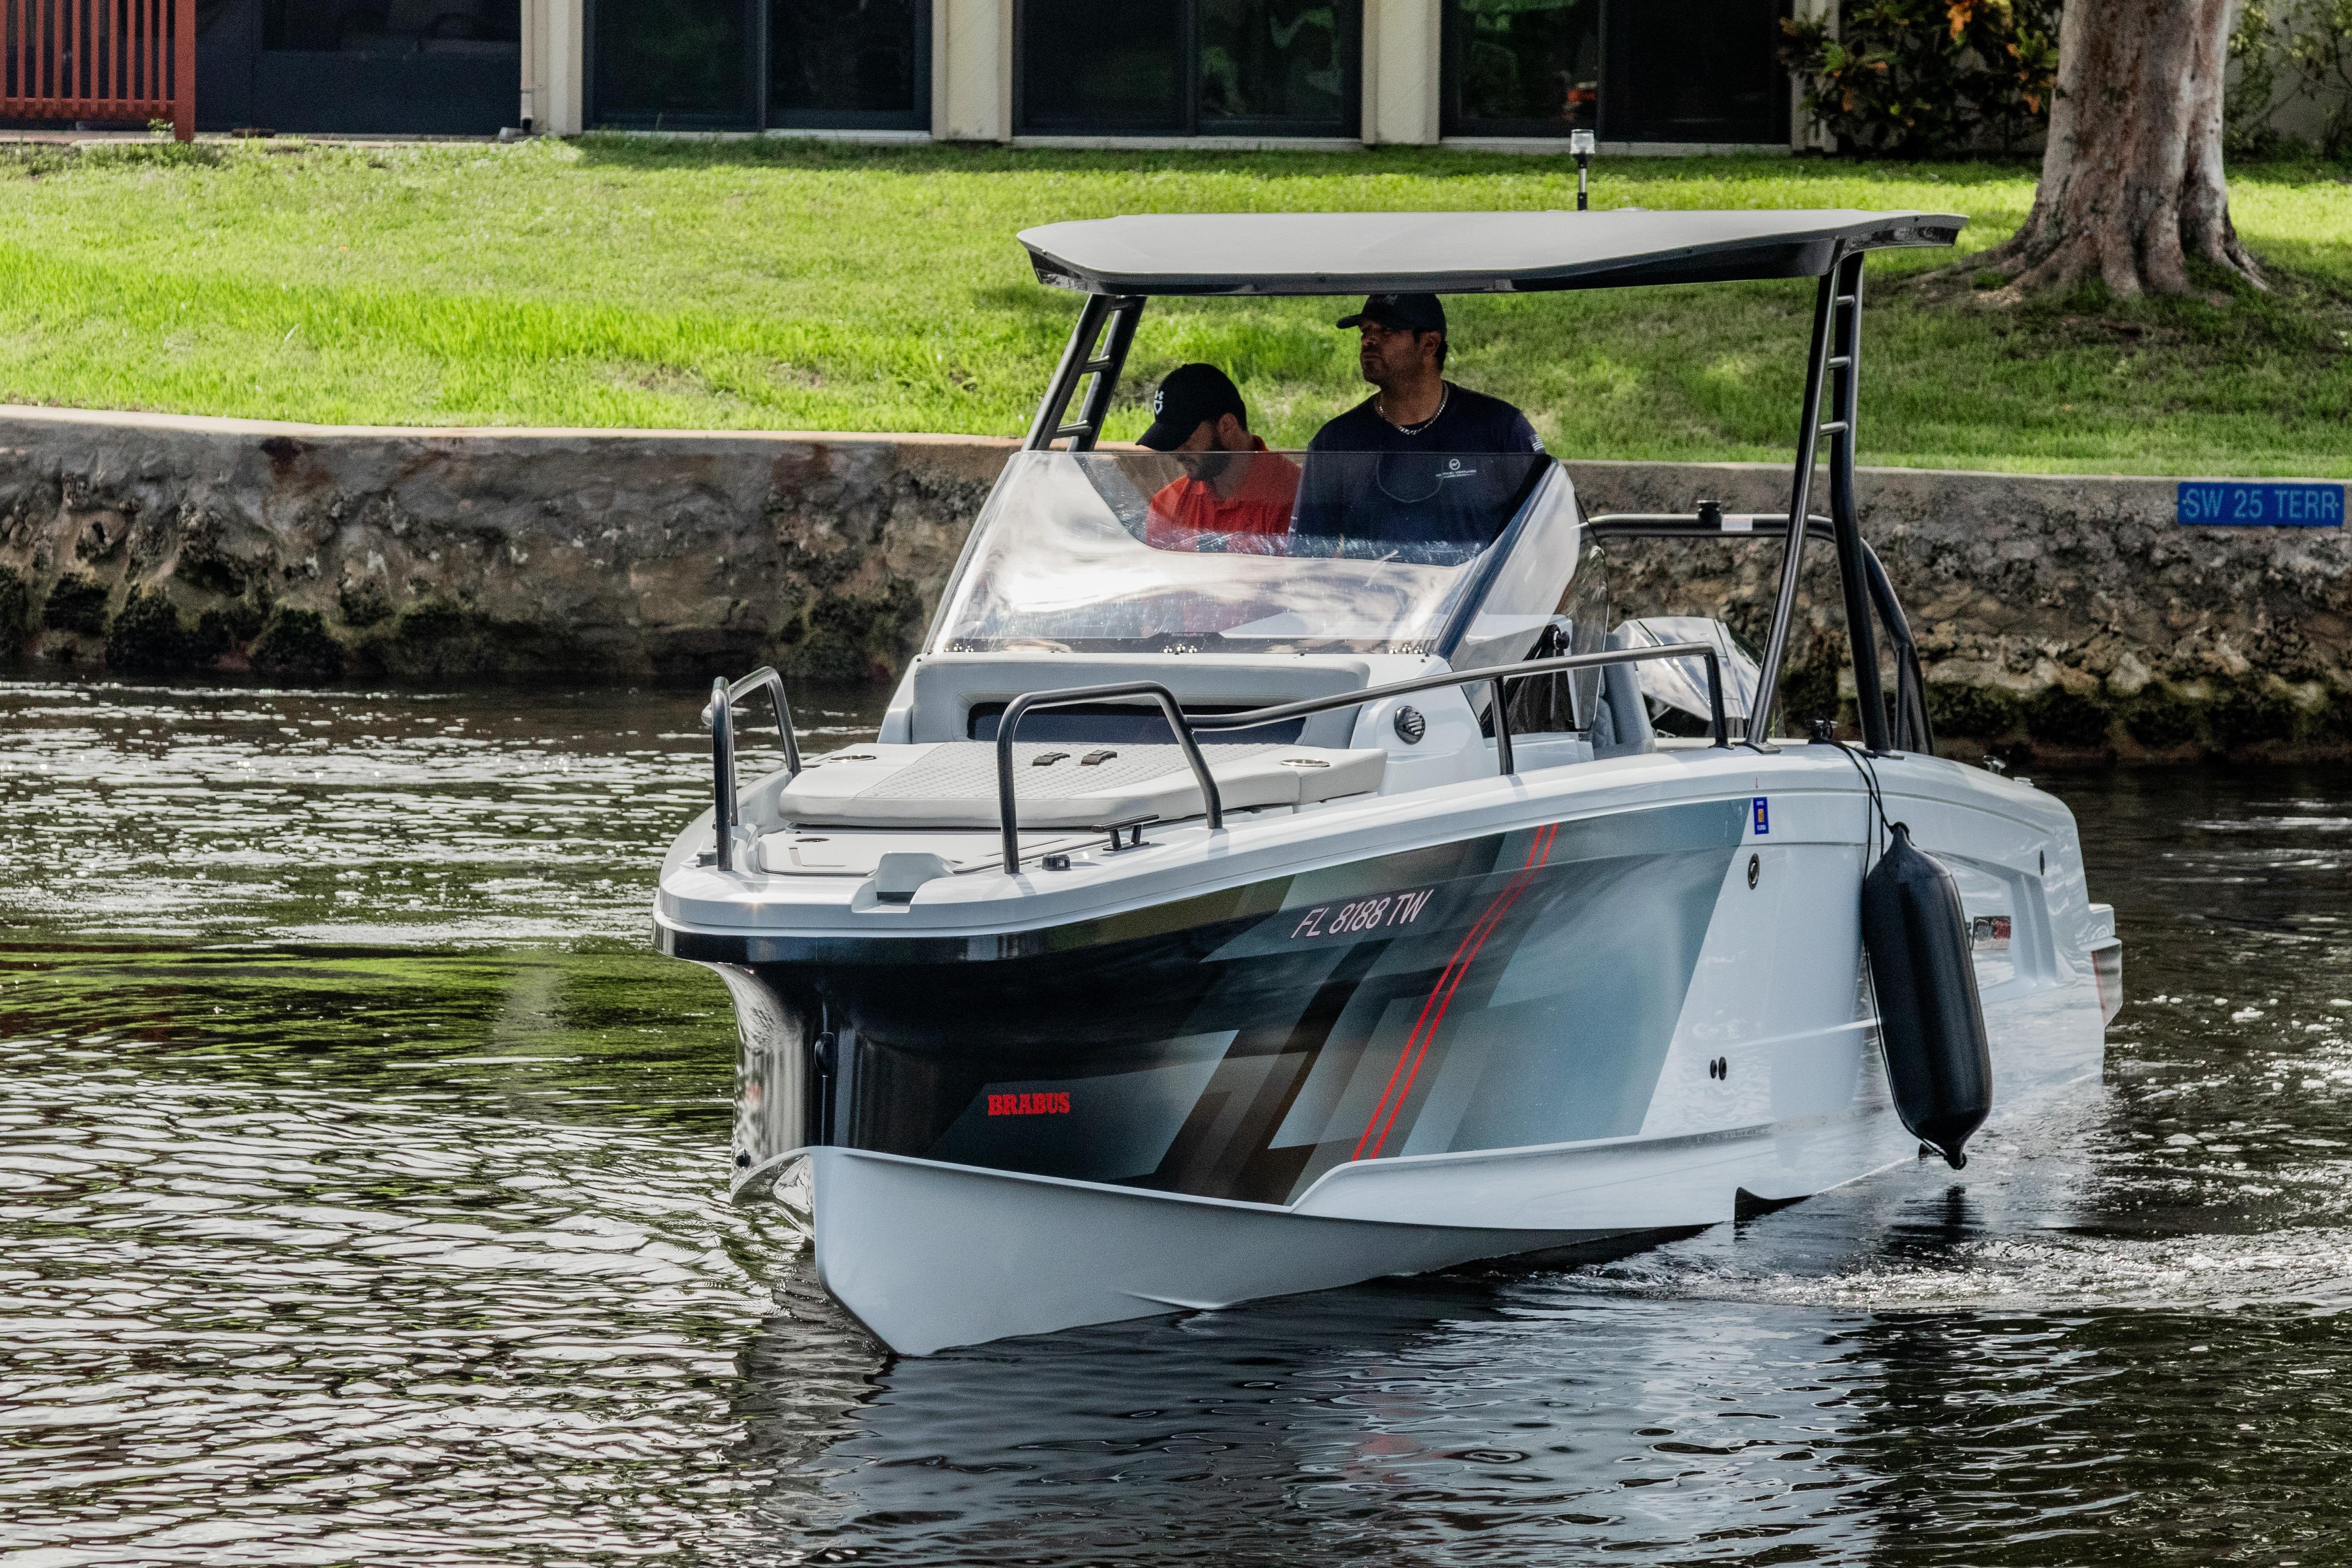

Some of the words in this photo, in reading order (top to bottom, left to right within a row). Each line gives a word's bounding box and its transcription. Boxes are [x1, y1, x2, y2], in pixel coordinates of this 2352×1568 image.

[2185, 488, 2224, 519] SW
[2234, 489, 2263, 519] 25
[2275, 490, 2337, 519] TERR
[1290, 907, 1330, 938] FL
[1328, 897, 1391, 934] 8188
[1386, 888, 1435, 926] TW
[988, 1093, 1070, 1115] BRABUS
